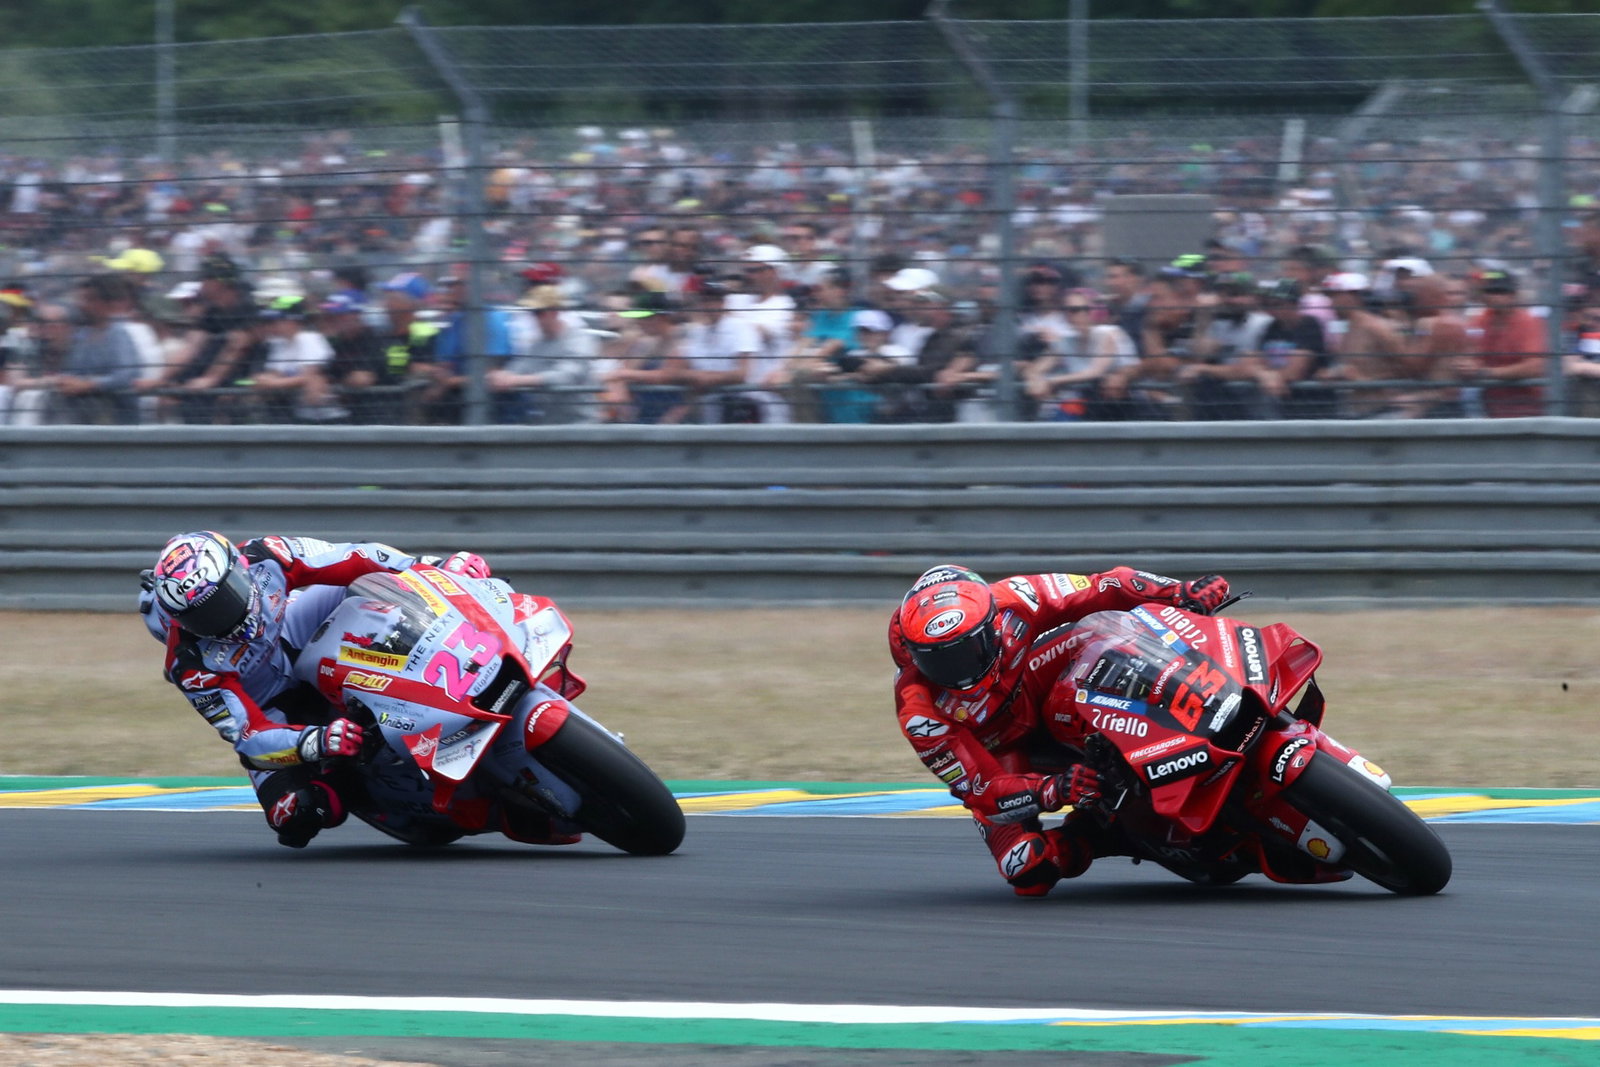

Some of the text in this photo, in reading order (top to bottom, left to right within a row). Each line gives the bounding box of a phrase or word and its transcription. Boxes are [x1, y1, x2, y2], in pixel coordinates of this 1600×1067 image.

[180, 570, 205, 594] KYT
[927, 615, 961, 633] SUOMY
[405, 613, 456, 672] THE NEXT
[1242, 628, 1264, 681] Lenovo
[347, 648, 400, 667] Antangin
[422, 621, 501, 702] 23
[1090, 695, 1132, 710] ADVANCE
[1169, 660, 1227, 732] 63
[380, 712, 416, 731] Unibat
[1101, 712, 1148, 737] riello
[1129, 736, 1187, 760] FRECCIAROSSA
[1271, 737, 1309, 783] Lenovo
[1146, 751, 1208, 780] Lenovo
[998, 794, 1032, 810] Lenovo
